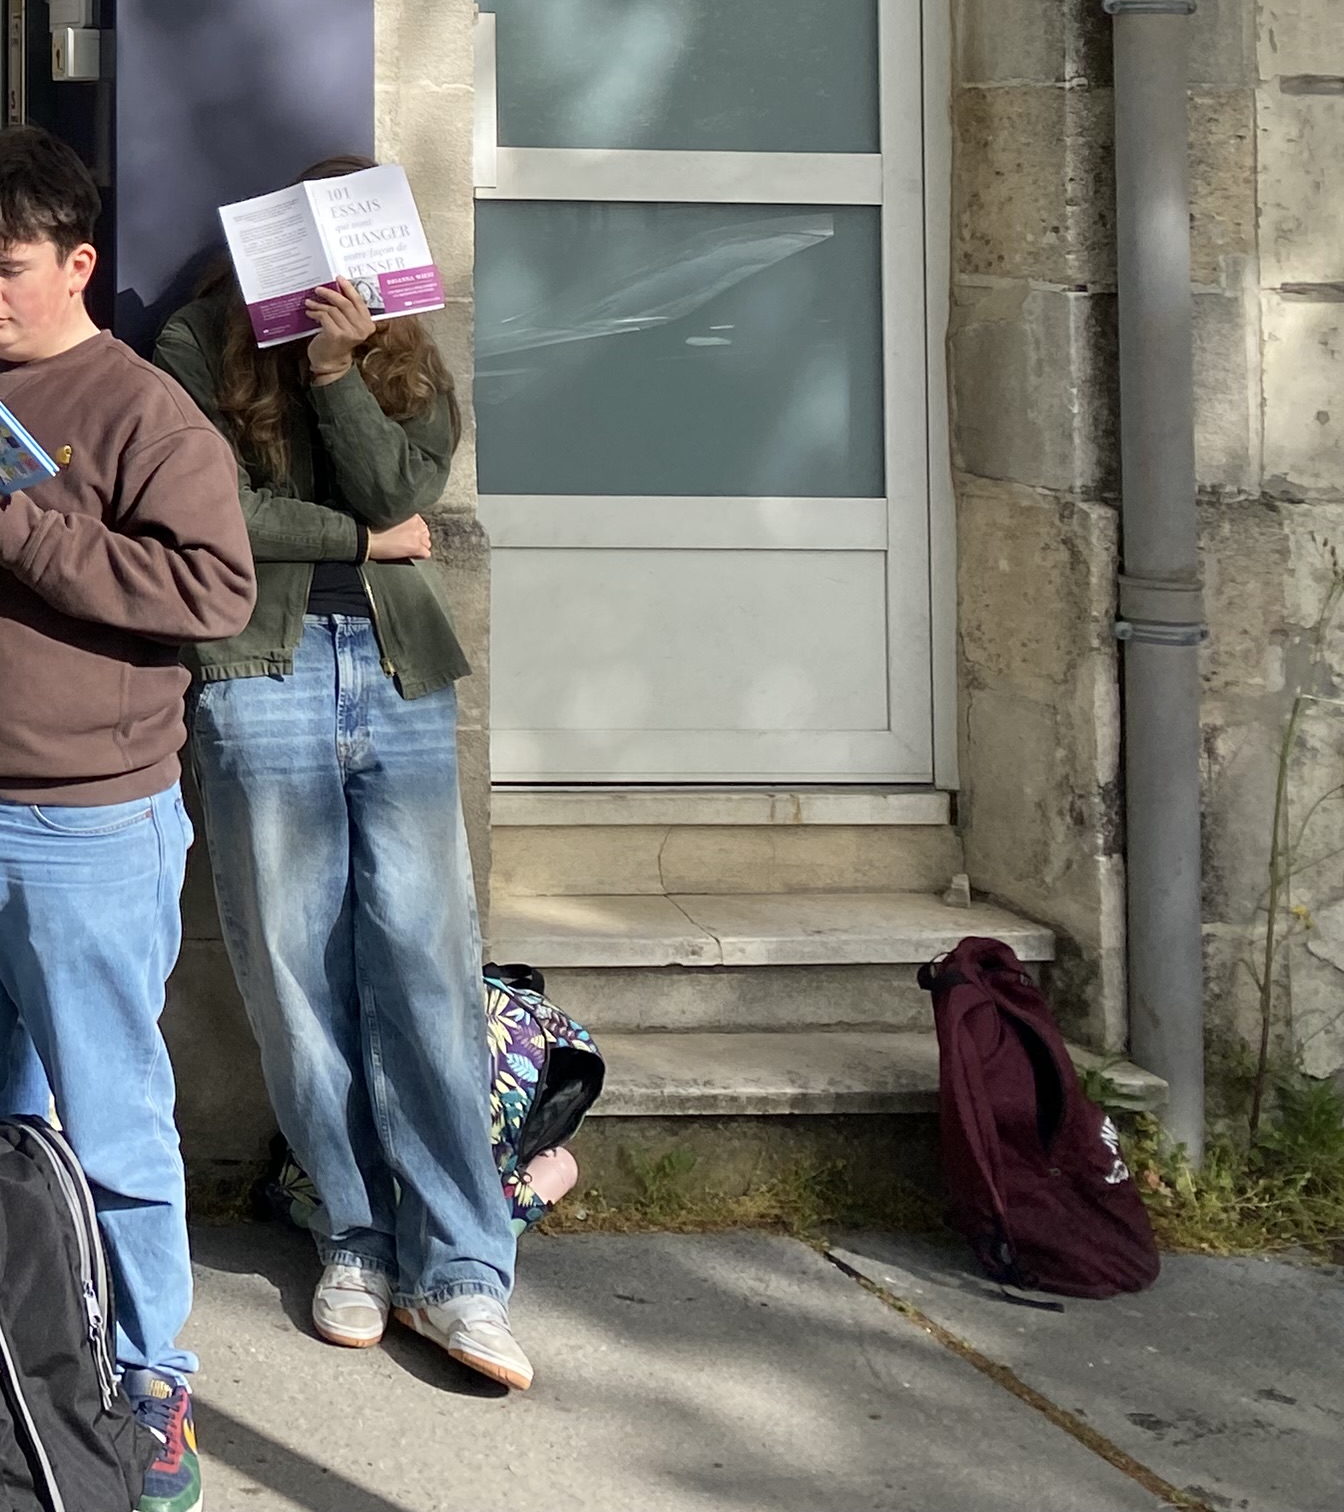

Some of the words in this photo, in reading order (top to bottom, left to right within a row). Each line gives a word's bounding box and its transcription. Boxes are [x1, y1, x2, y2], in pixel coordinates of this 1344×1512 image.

[327, 187, 350, 201] 101
[331, 198, 381, 219] ESSAIS
[339, 225, 410, 248] CHANGER
[348, 256, 405, 278] PENSER
